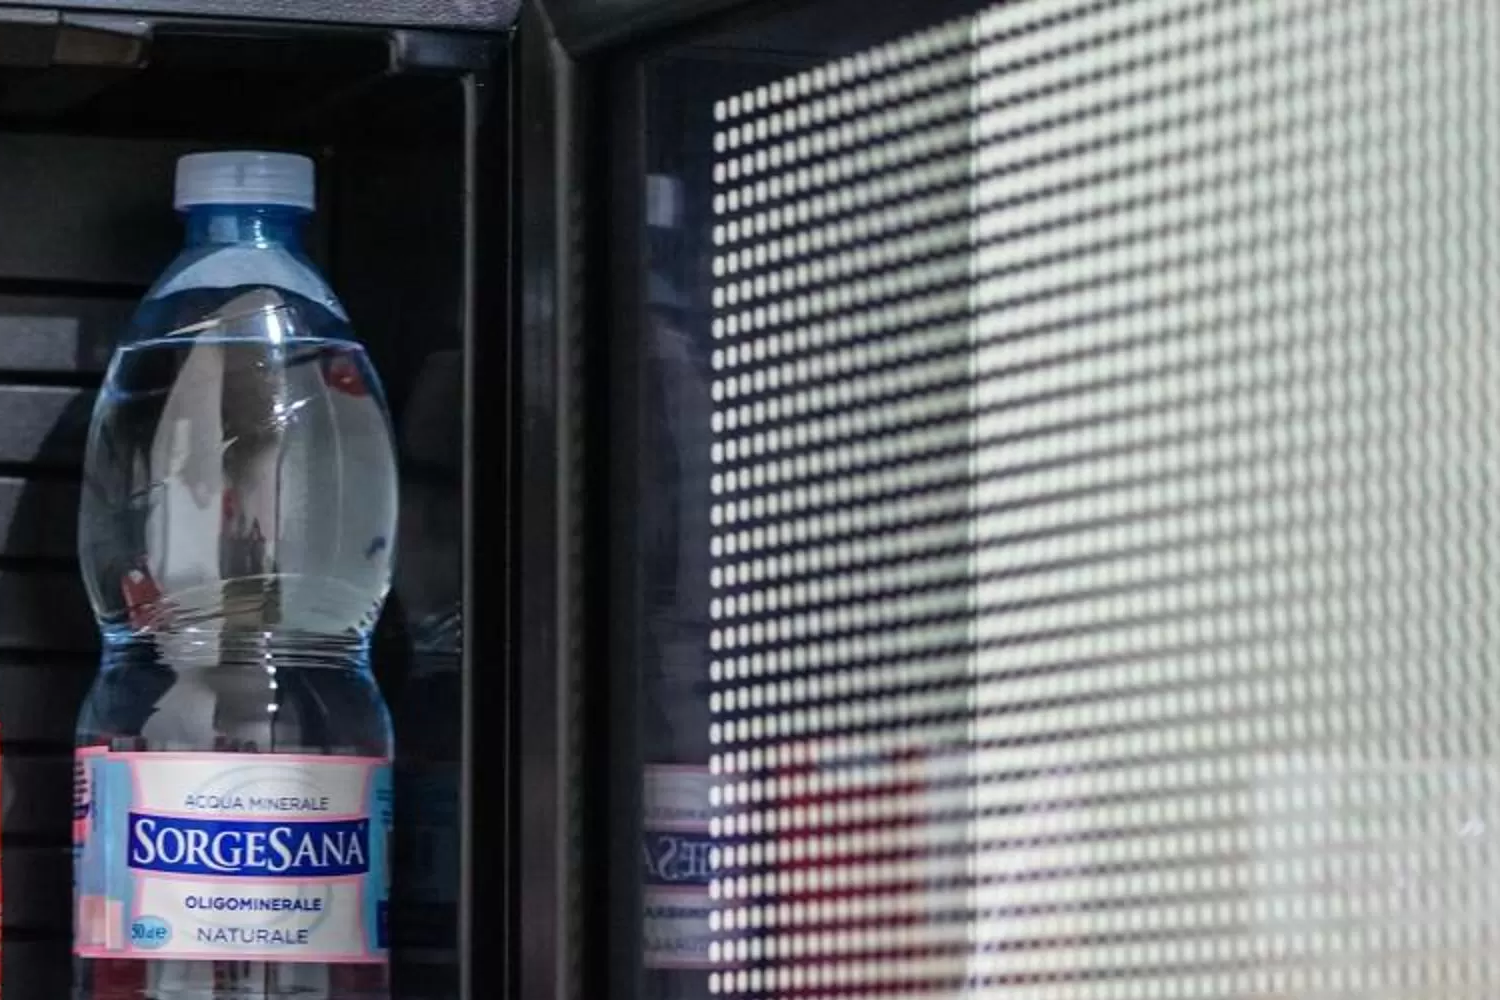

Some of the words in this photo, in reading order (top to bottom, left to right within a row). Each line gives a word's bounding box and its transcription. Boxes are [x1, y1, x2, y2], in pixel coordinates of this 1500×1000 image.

[184, 794, 244, 811] ACQUA
[248, 796, 329, 811] MINERALE
[184, 894, 322, 911] OLIGOMINERALE
[197, 927, 309, 945] NATURALE
